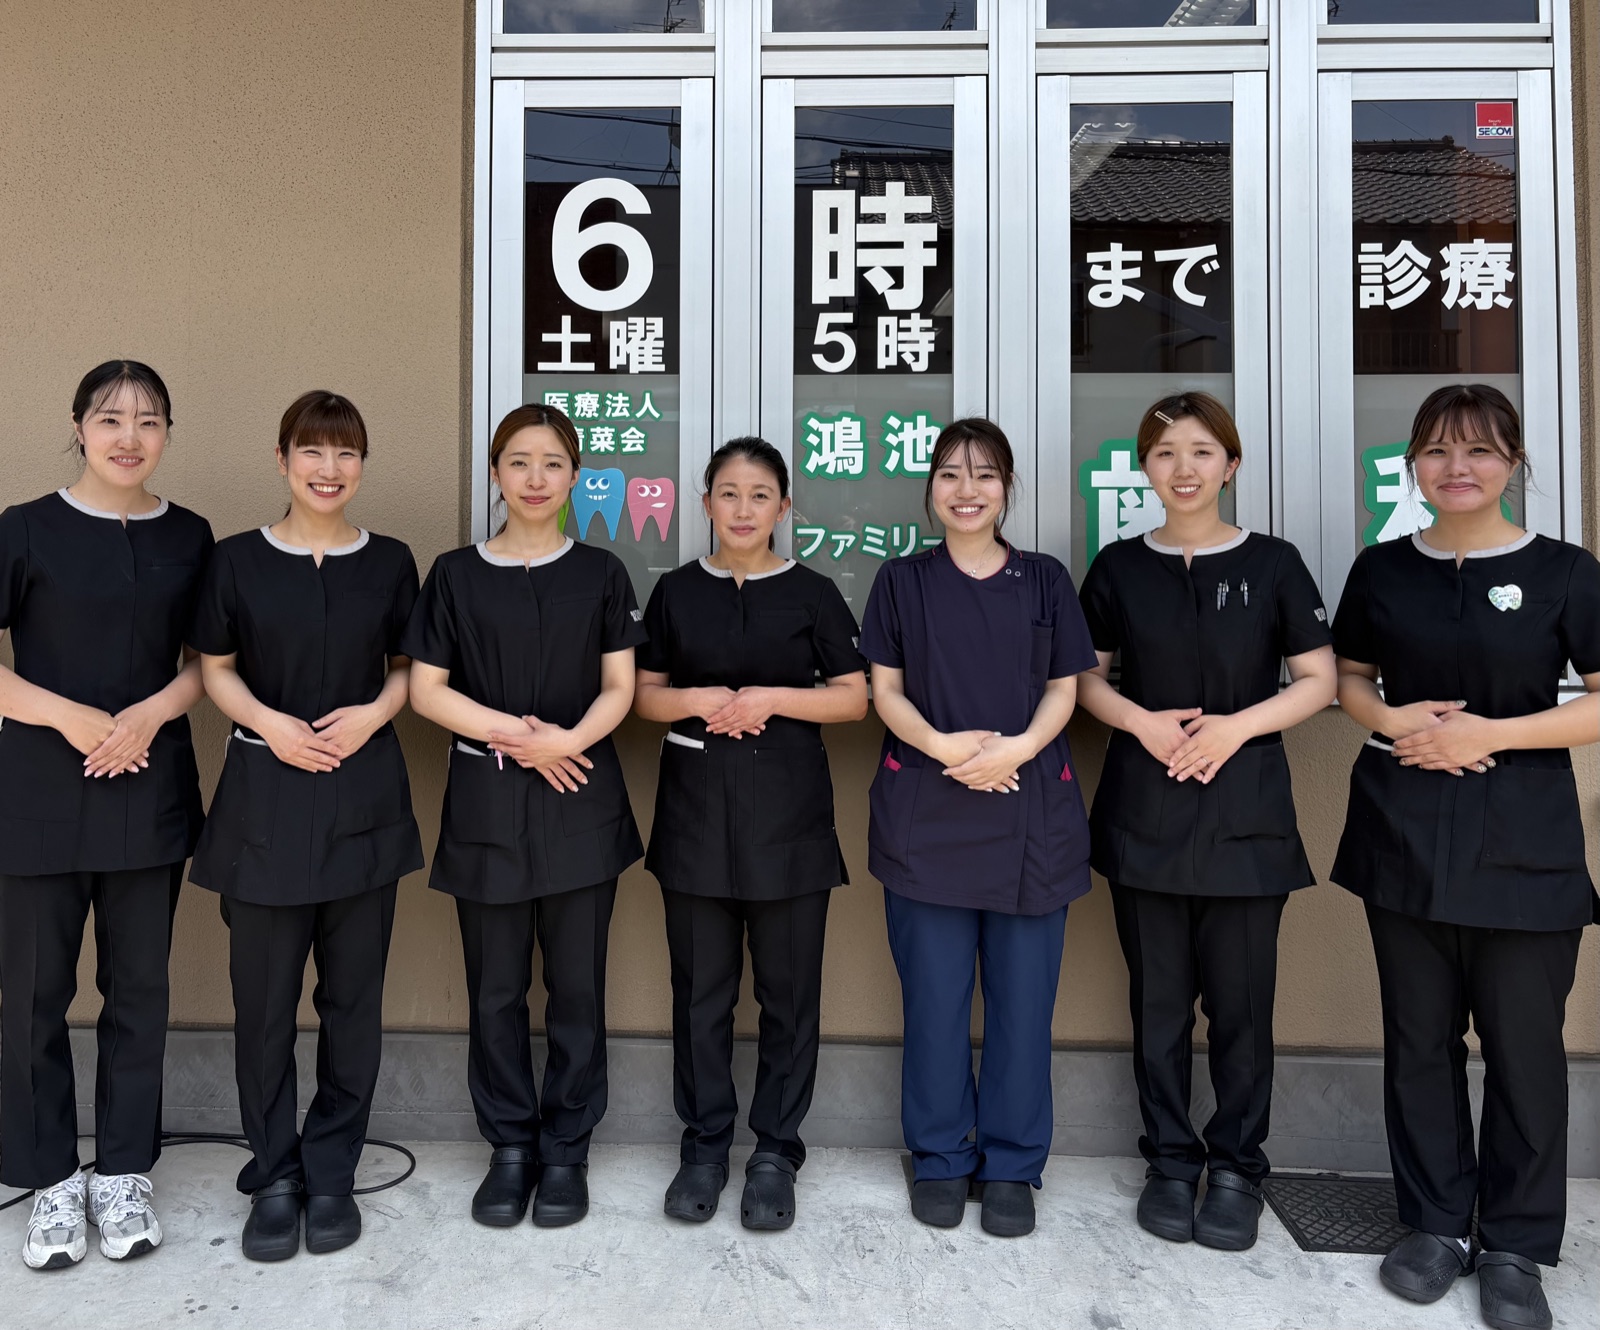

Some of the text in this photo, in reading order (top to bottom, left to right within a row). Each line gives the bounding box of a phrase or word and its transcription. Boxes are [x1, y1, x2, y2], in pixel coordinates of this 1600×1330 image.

[1478, 127, 1512, 136] SECOM
[551, 177, 1515, 312] 6 時 まで 診療
[537, 315, 666, 374] 土曜
[544, 392, 661, 419] 医療法人
[805, 415, 941, 475] 鴻池
[796, 525, 944, 558] ファミリー
